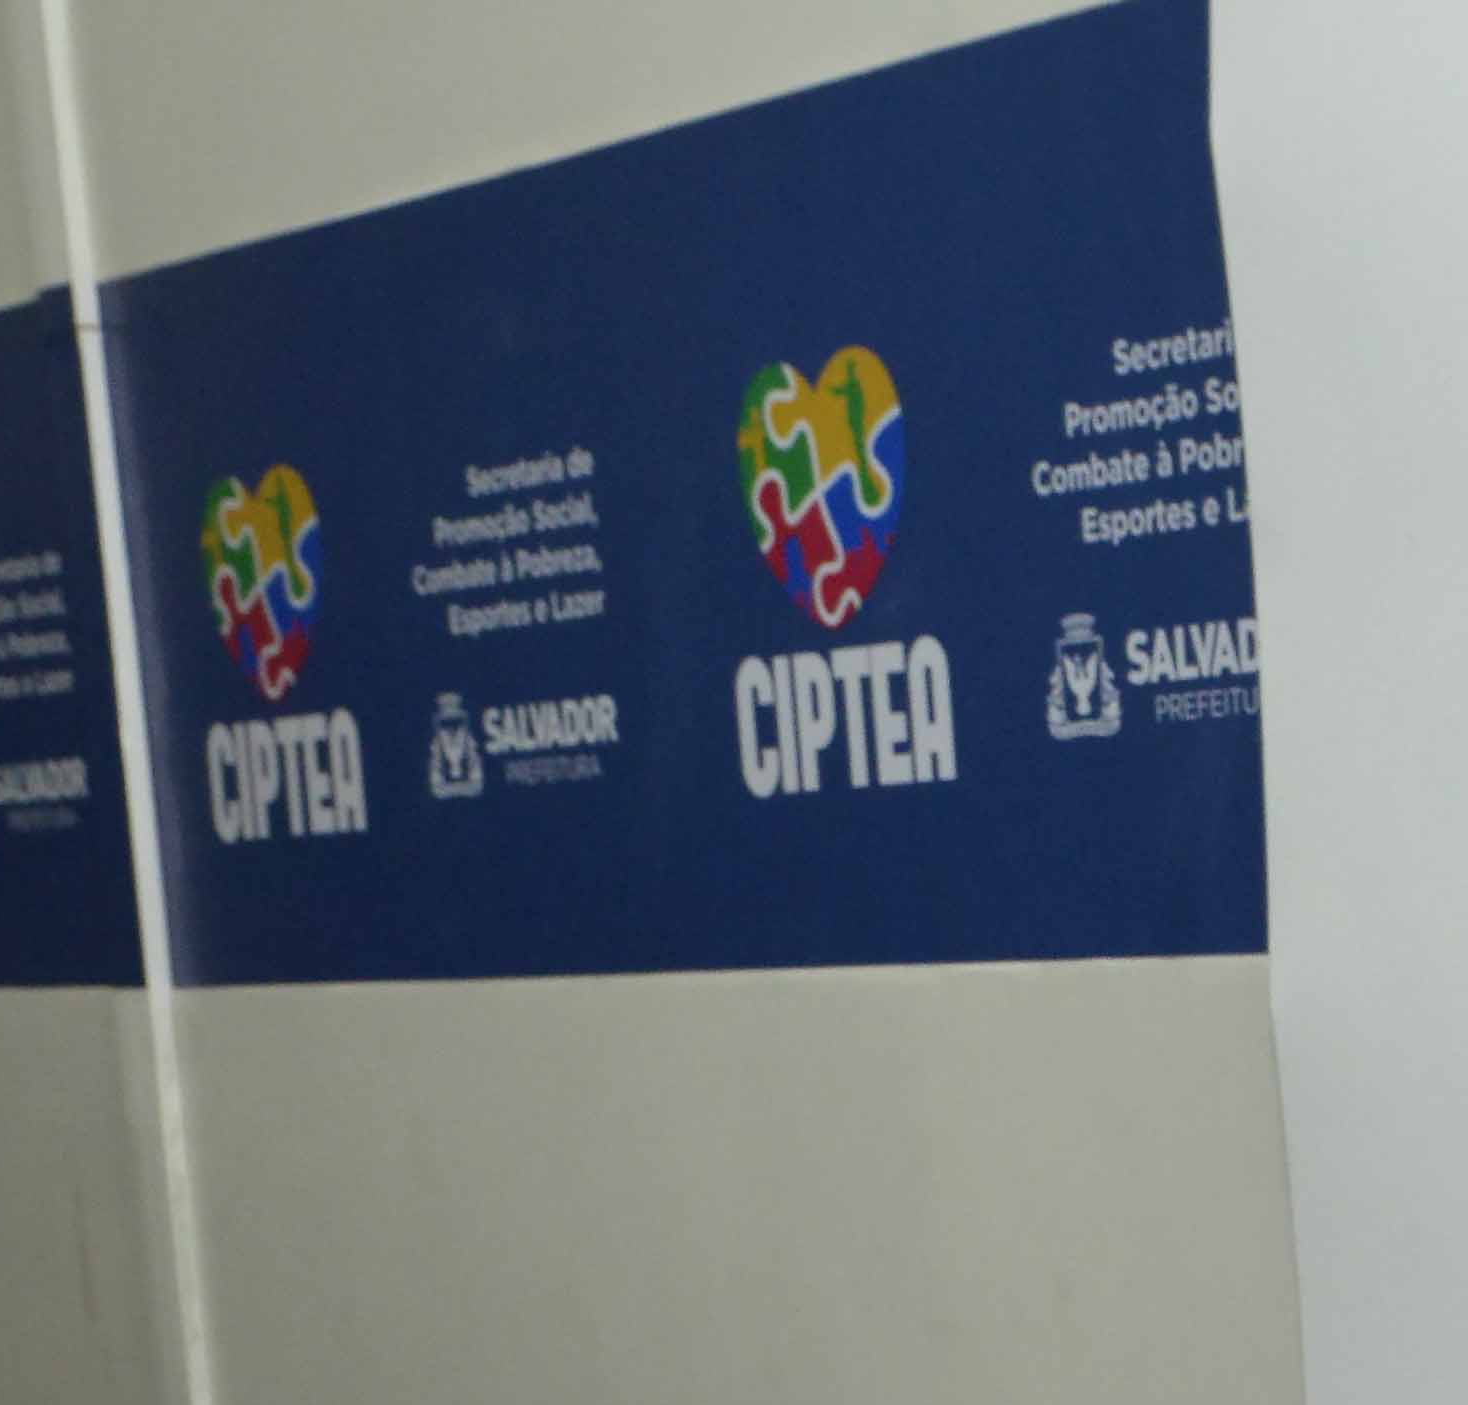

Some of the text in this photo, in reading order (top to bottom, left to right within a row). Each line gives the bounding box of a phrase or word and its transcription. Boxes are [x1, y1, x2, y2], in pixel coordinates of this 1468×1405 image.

[1112, 320, 1236, 375] Secretari
[1064, 382, 1198, 438] Promoção
[1031, 432, 1245, 497] Combate à Pobr
[1081, 497, 1196, 546] Esportes
[1201, 496, 1220, 526] e
[1125, 617, 1260, 686] SALVAD
[482, 694, 619, 755] SALVADOR
[735, 634, 958, 799] CIPTEA
[1154, 682, 1261, 723] PREFEITU
[206, 707, 368, 844] CIPTEA
